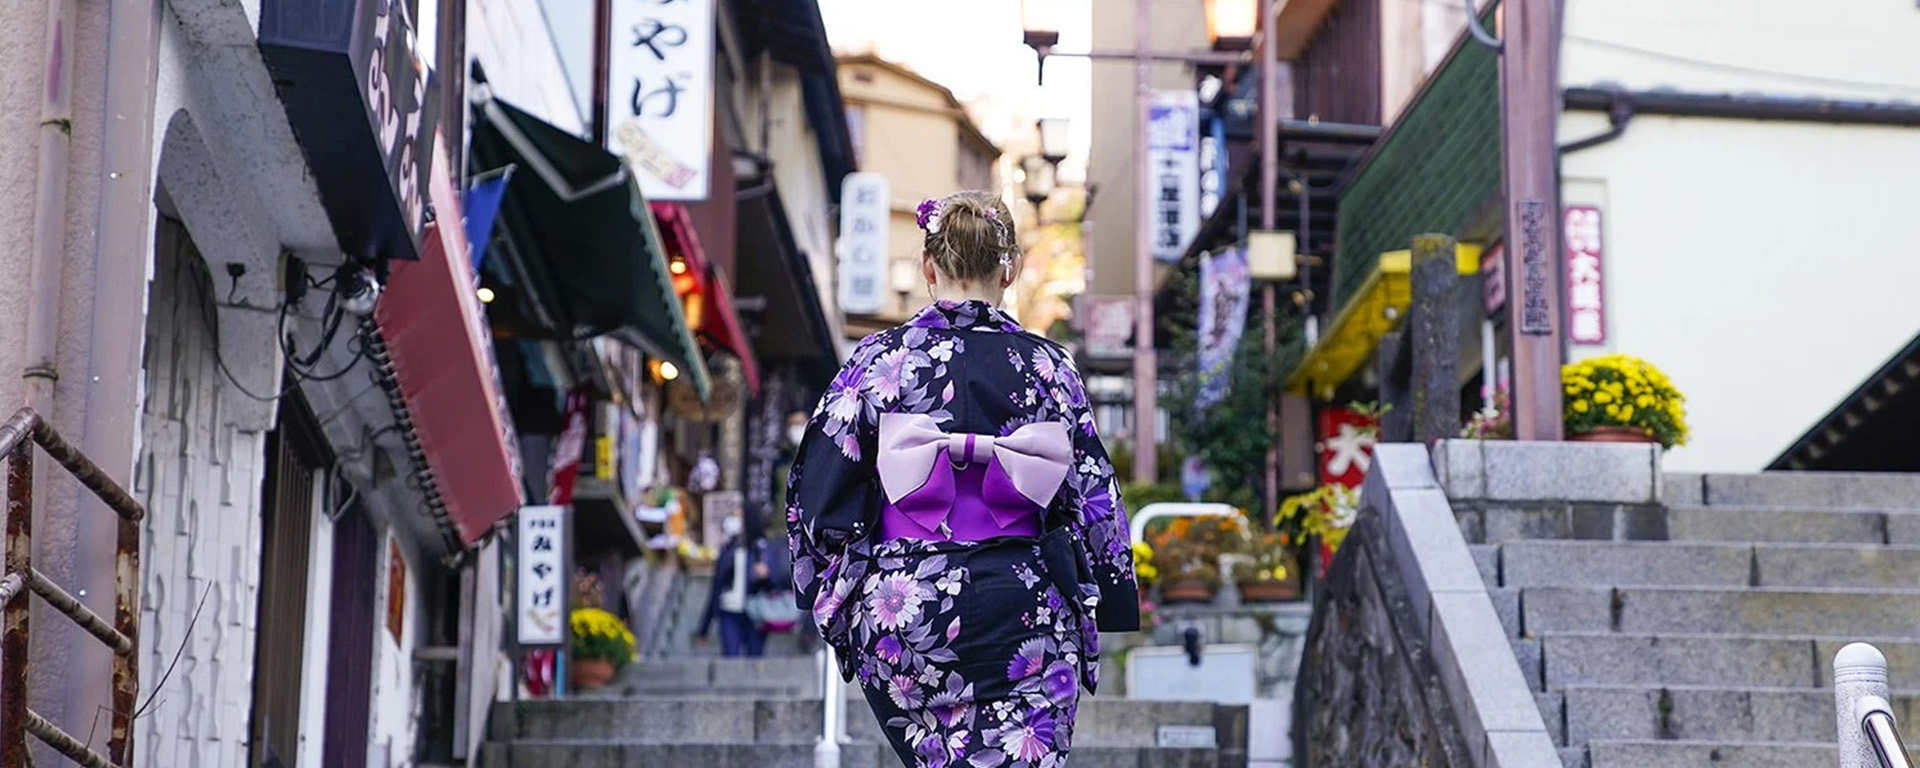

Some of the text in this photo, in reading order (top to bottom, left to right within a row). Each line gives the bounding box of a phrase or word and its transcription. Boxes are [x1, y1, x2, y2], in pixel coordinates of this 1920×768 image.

[632, 0, 692, 118] やげ
[532, 535, 553, 607] みやげ
